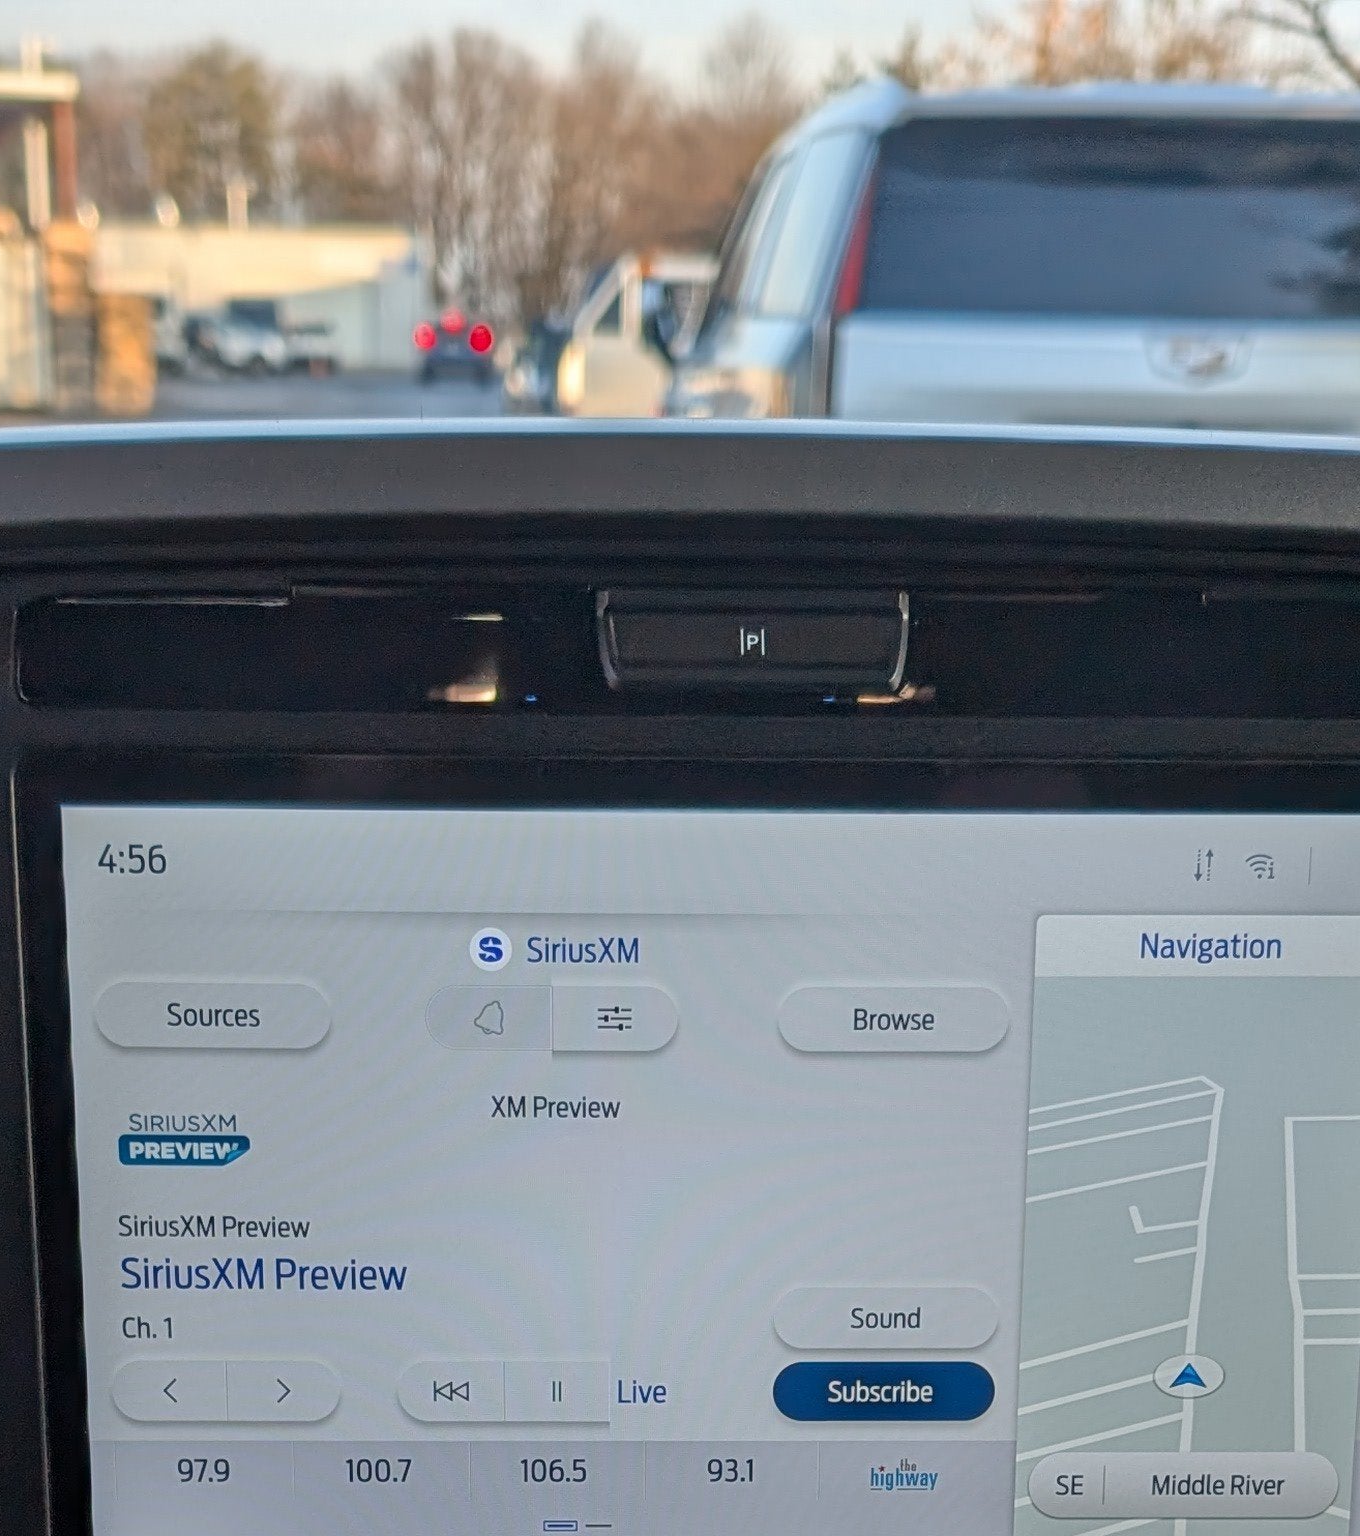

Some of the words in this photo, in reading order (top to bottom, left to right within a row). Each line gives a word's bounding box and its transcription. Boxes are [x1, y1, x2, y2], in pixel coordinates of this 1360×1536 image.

[98, 844, 167, 875] 4:56
[526, 936, 640, 964] SiriusXM
[1140, 933, 1282, 964] Navigation
[167, 1003, 261, 1028] Sources
[852, 1007, 935, 1031] Browse
[491, 1096, 528, 1119] XM
[532, 1095, 621, 1119] Preview
[128, 1114, 238, 1132] SIRIUSXM
[128, 1140, 242, 1161] PREVIEW
[118, 1216, 216, 1238] SiriusXM
[222, 1216, 310, 1239] Preview
[120, 1258, 264, 1290] SiriusXM
[275, 1258, 408, 1291] Preview
[122, 1317, 157, 1339] Ch.
[162, 1317, 173, 1339] 1
[851, 1308, 921, 1329] Sound
[617, 1381, 667, 1404] Live
[828, 1381, 933, 1403] Subscribe
[177, 1459, 230, 1482] 97.9
[346, 1459, 412, 1483] 100.7
[520, 1459, 587, 1483] 106.5
[707, 1459, 754, 1482] 93.1
[900, 1459, 917, 1472] the
[870, 1464, 938, 1491] highway
[1055, 1476, 1084, 1496] SE
[1151, 1474, 1224, 1496] Middle
[1230, 1474, 1284, 1496] River
